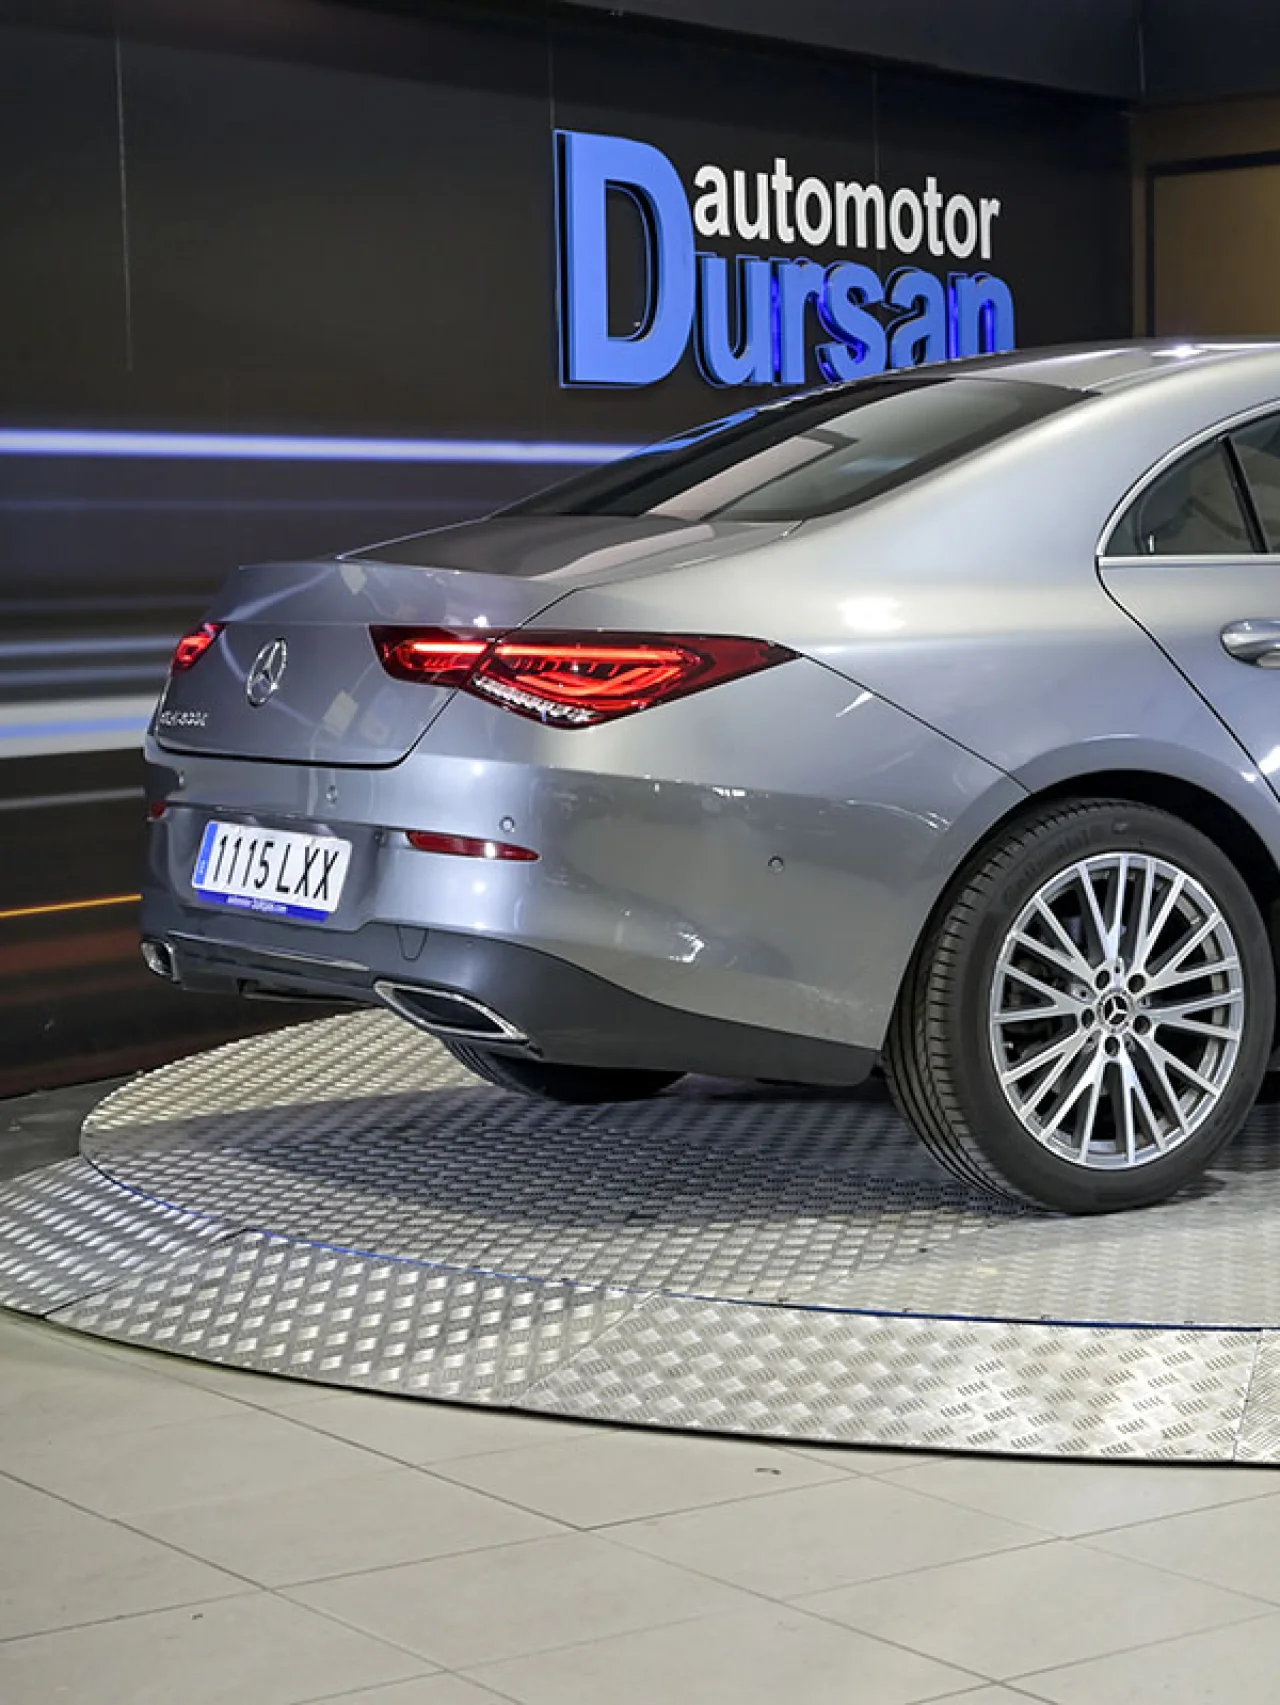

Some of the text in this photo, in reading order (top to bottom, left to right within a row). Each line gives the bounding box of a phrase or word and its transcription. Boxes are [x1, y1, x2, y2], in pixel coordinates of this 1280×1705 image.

[554, 129, 1016, 388] Dursan
[693, 157, 1001, 260] automotor
[213, 834, 340, 901] 1115 LXX
